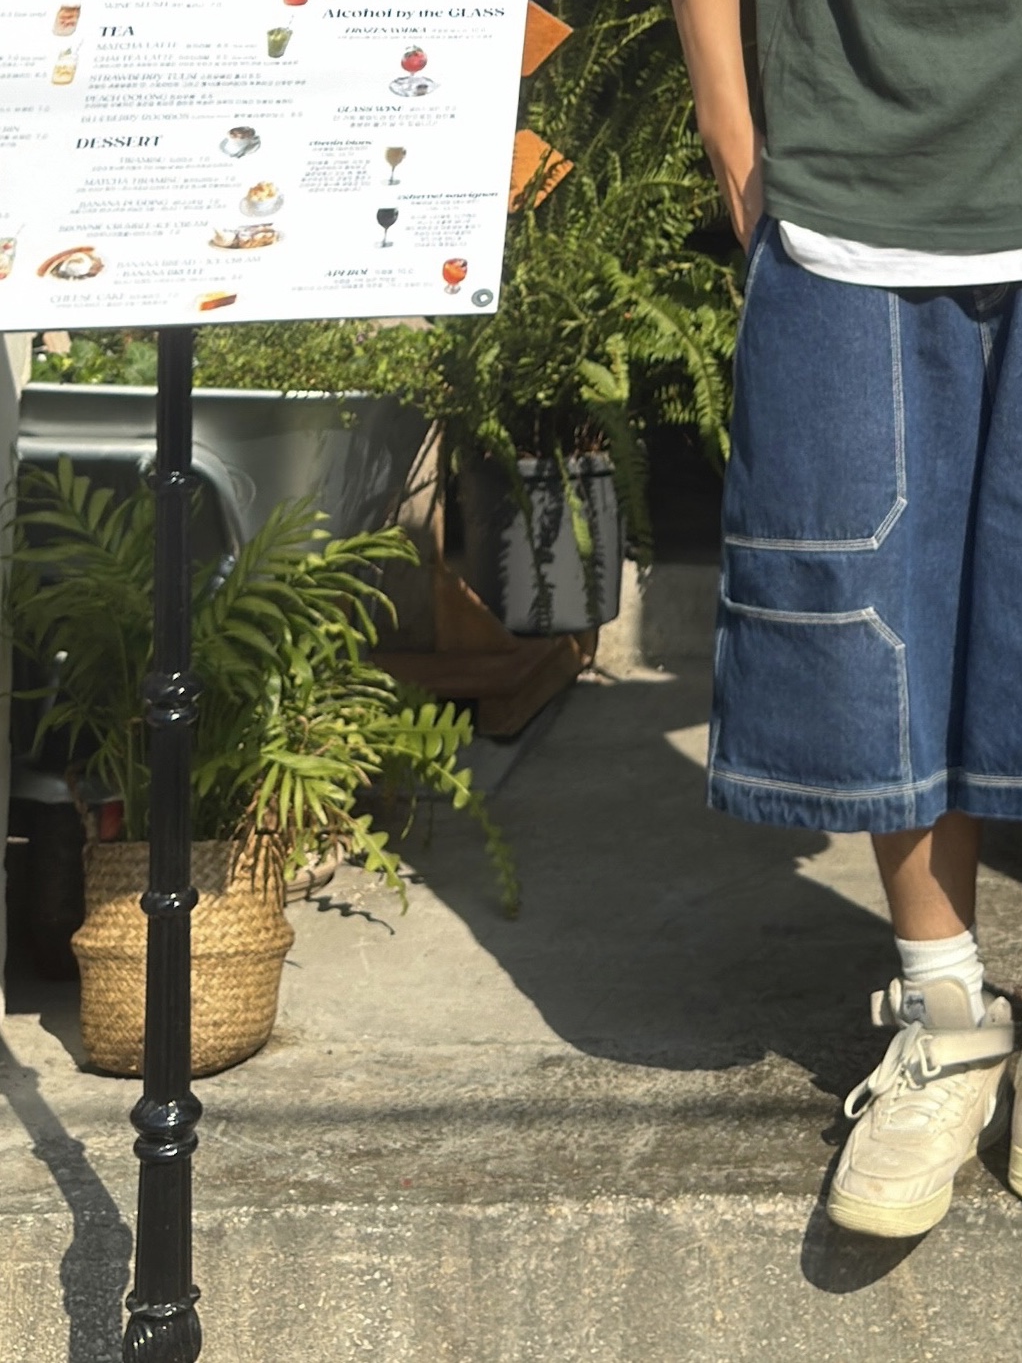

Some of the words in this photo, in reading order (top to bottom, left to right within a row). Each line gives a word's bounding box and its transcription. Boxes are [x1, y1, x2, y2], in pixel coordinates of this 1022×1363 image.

[322, 7, 392, 19] Alcohol
[396, 8, 416, 20] by
[419, 7, 444, 18] the
[448, 7, 505, 18] GLASS
[99, 25, 135, 38] TEA
[76, 135, 163, 150] DESSERT
